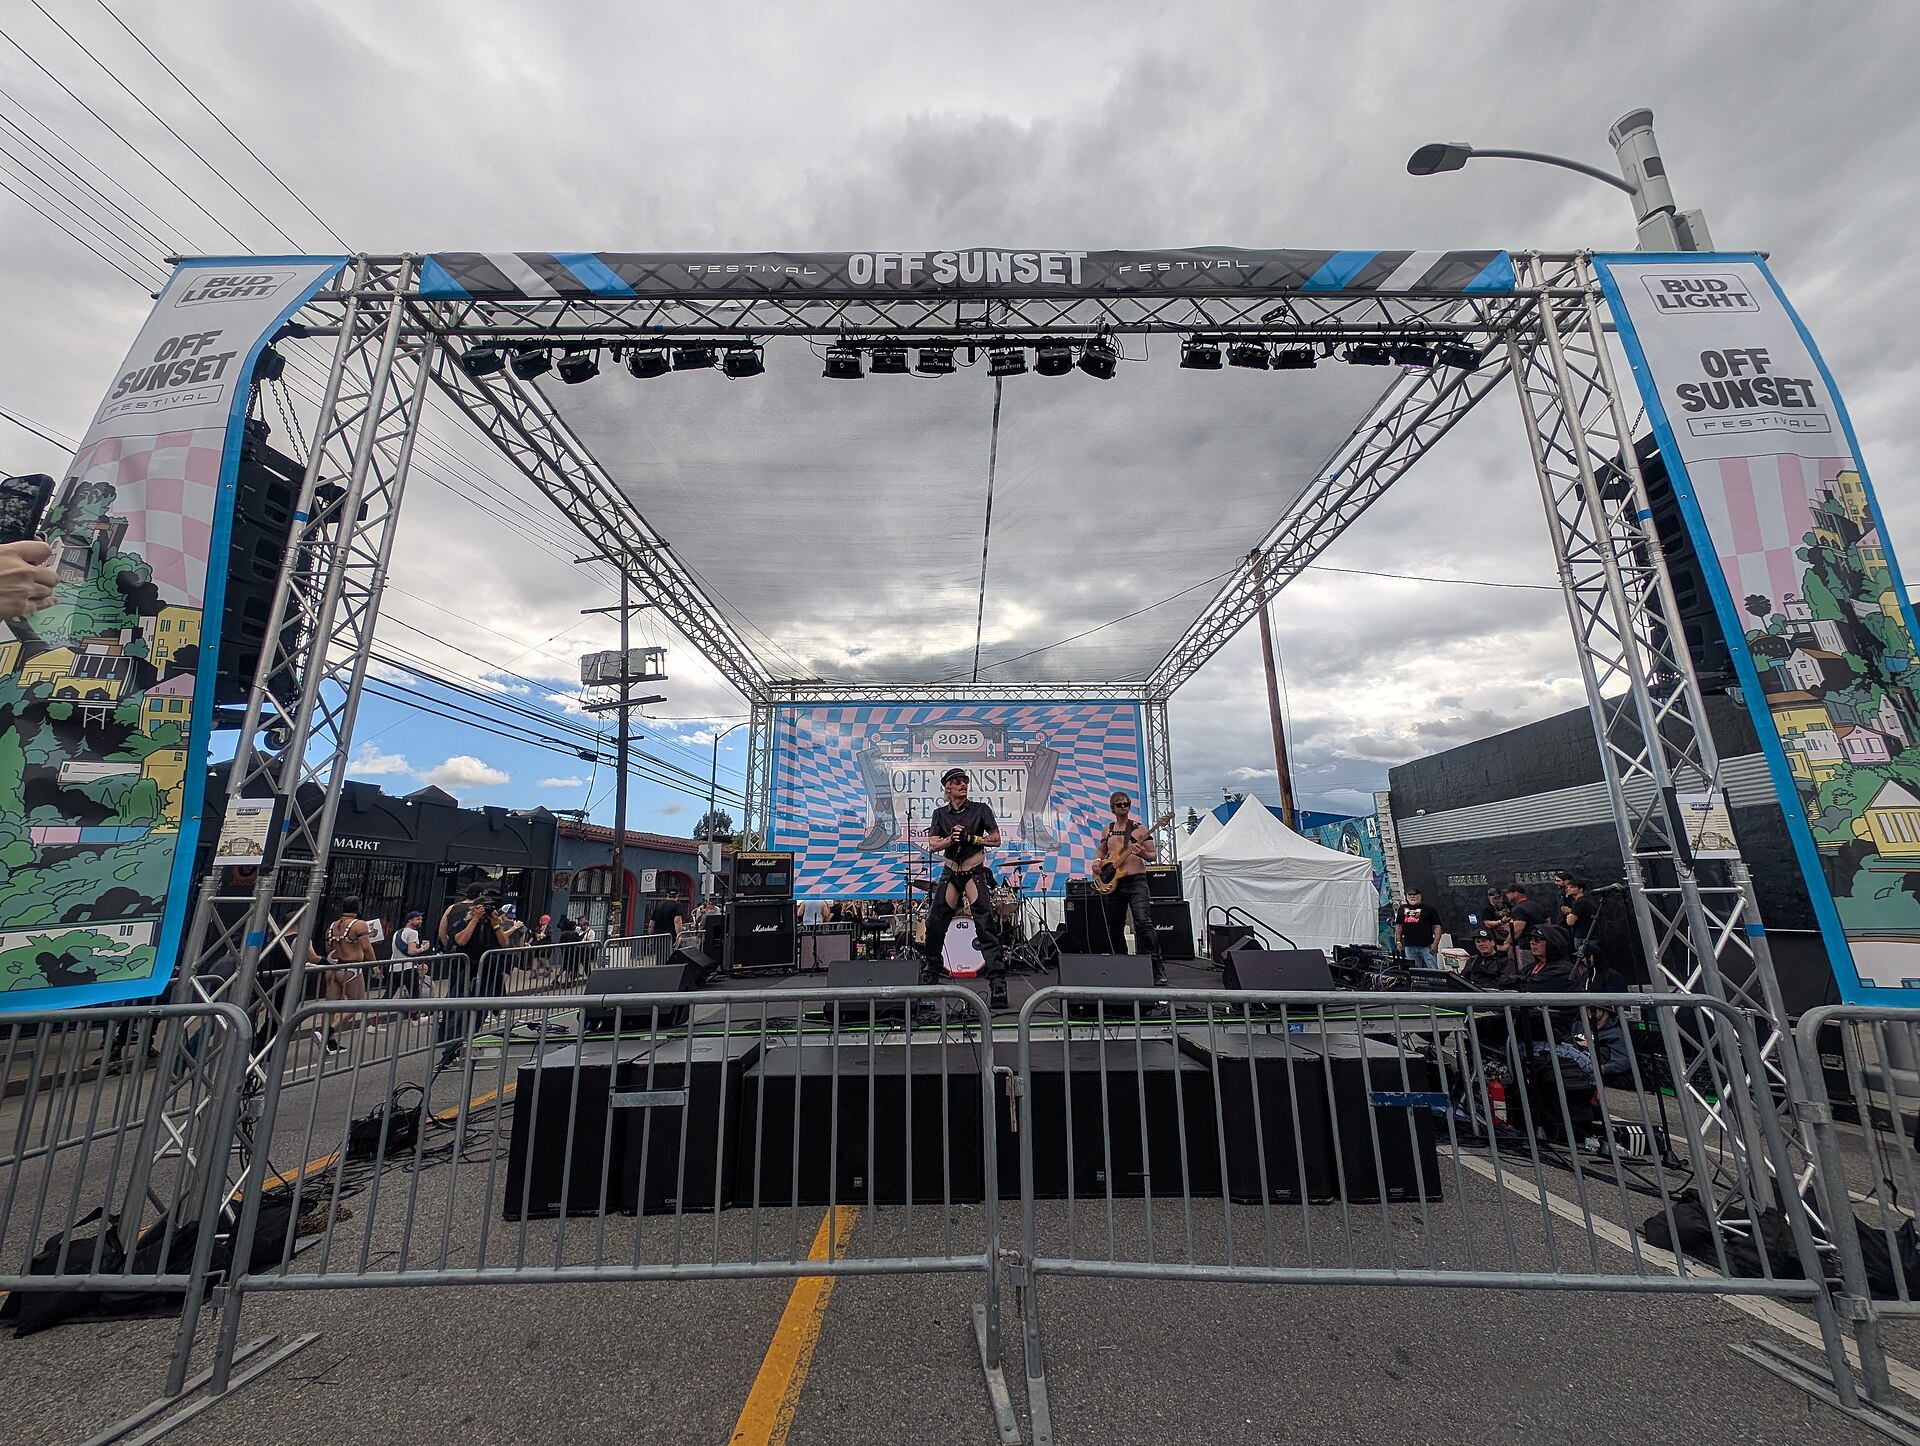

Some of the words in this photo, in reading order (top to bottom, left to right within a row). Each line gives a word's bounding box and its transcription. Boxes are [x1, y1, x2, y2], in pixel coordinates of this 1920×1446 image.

[687, 263, 817, 276] FESTIVAL
[847, 251, 926, 285] OFF
[932, 250, 1088, 286] SUNSET
[1118, 258, 1250, 275] FESTIVAL
[204, 273, 274, 288] BUD
[1661, 278, 1728, 293] BUD
[182, 284, 279, 302] LIGHT
[153, 330, 224, 364] OFF
[1700, 347, 1772, 379] OFF
[111, 350, 238, 400] SUNSET
[1676, 376, 1820, 413] SUNSET
[108, 393, 208, 416] FESTIVAL
[1703, 416, 1817, 430] FESTIVAL
[938, 733, 979, 745] 2025
[892, 769, 935, 793] OFF
[940, 767, 1025, 792] NSET
[333, 837, 381, 851] MARKT
[752, 924, 778, 932] Marshall
